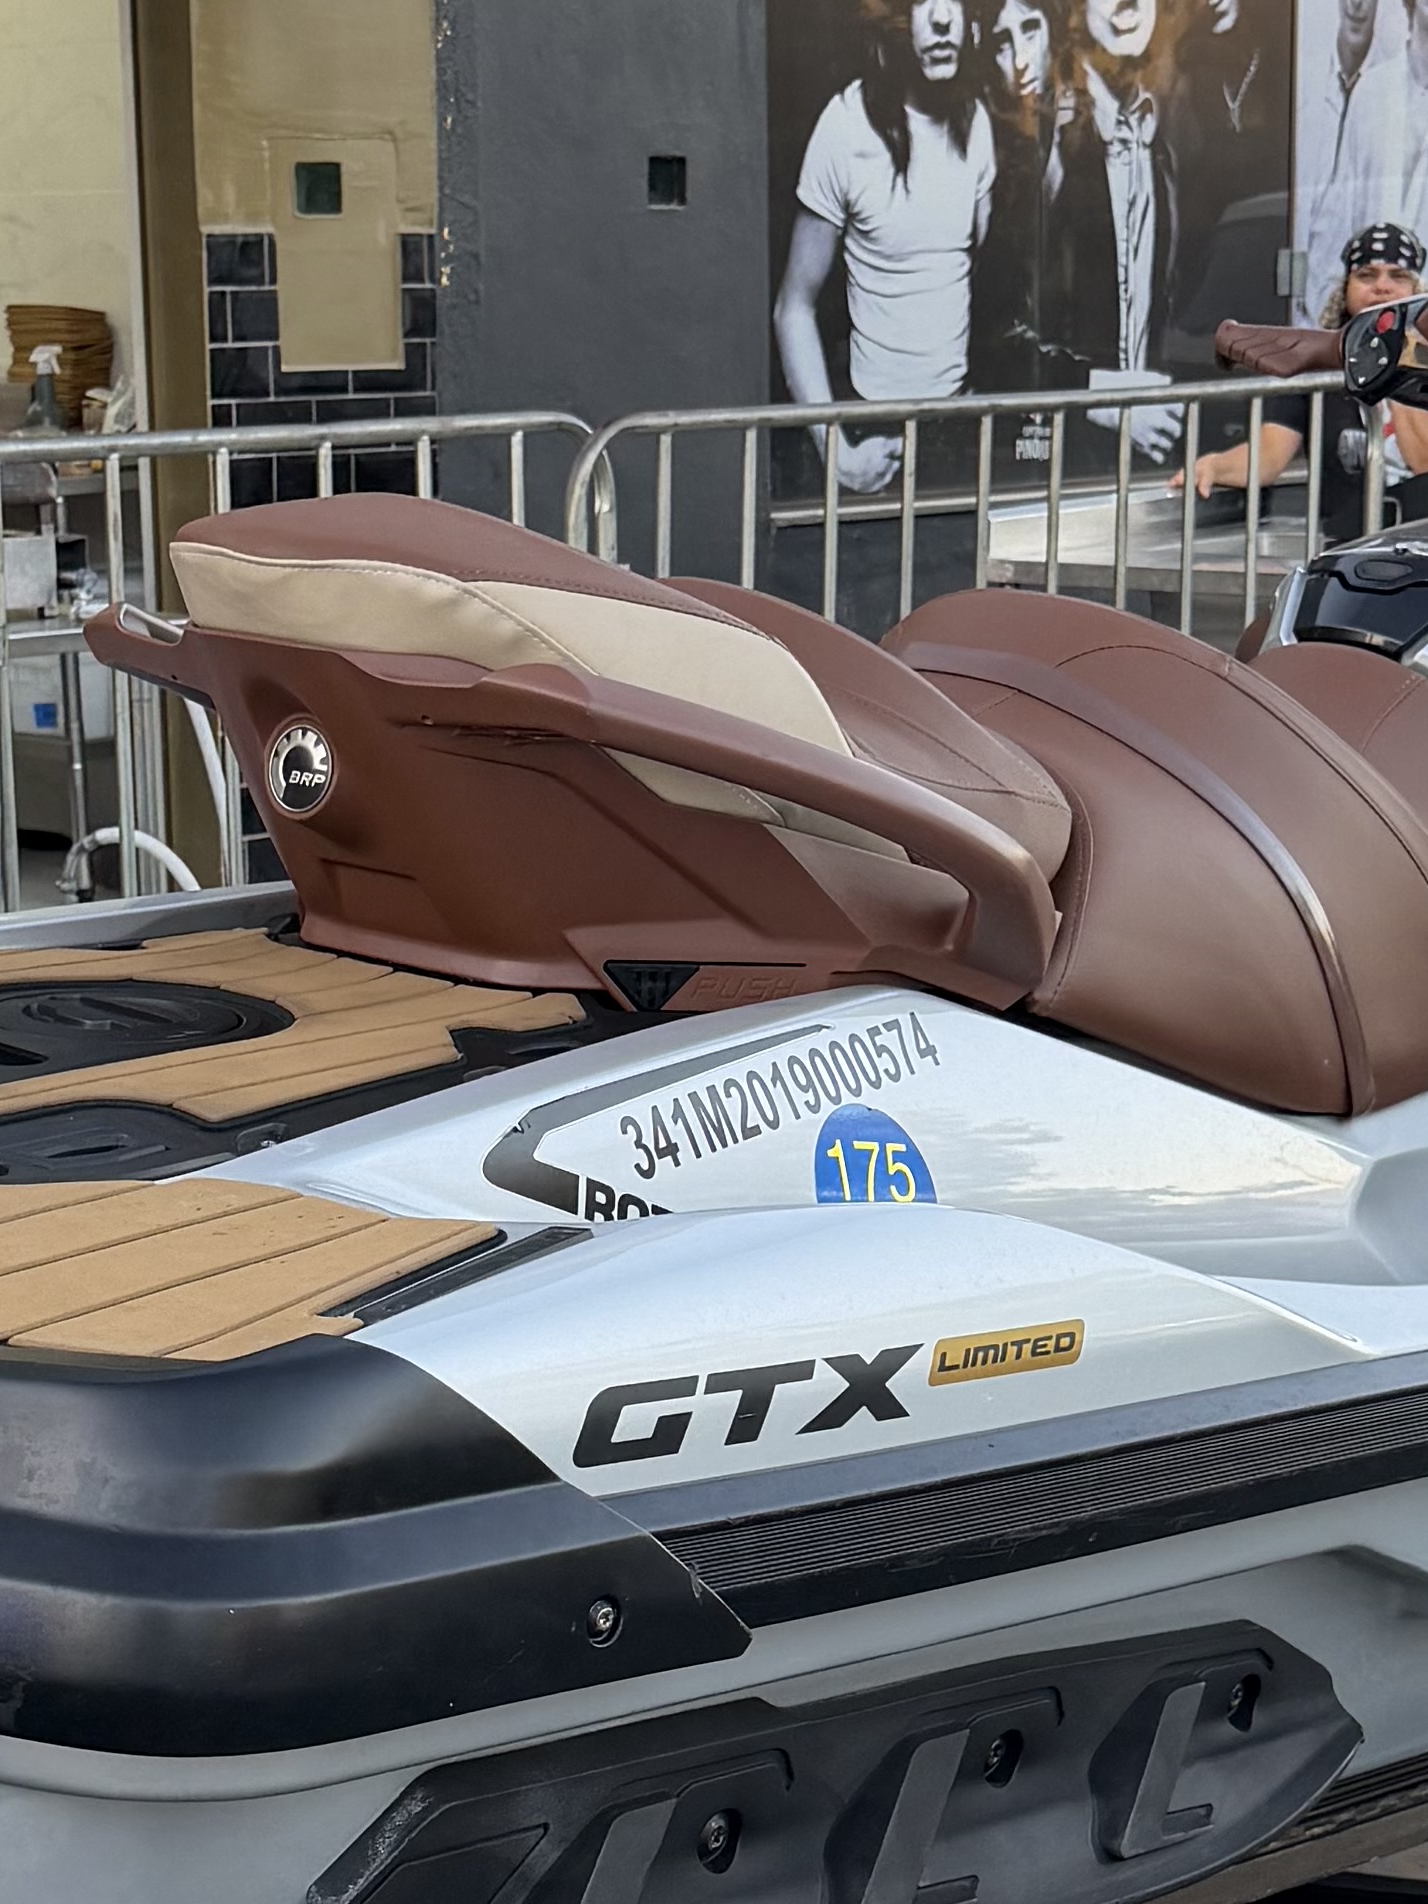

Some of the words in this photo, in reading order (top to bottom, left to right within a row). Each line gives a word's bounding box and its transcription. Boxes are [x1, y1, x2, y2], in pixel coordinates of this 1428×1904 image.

[288, 769, 327, 788] BRP
[690, 974, 798, 1002] PUSH
[619, 1010, 941, 1180] 341M2019000574
[825, 1137, 916, 1204] 175
[572, 1342, 926, 1469] GTX
[937, 1330, 1078, 1374] LIMITED
